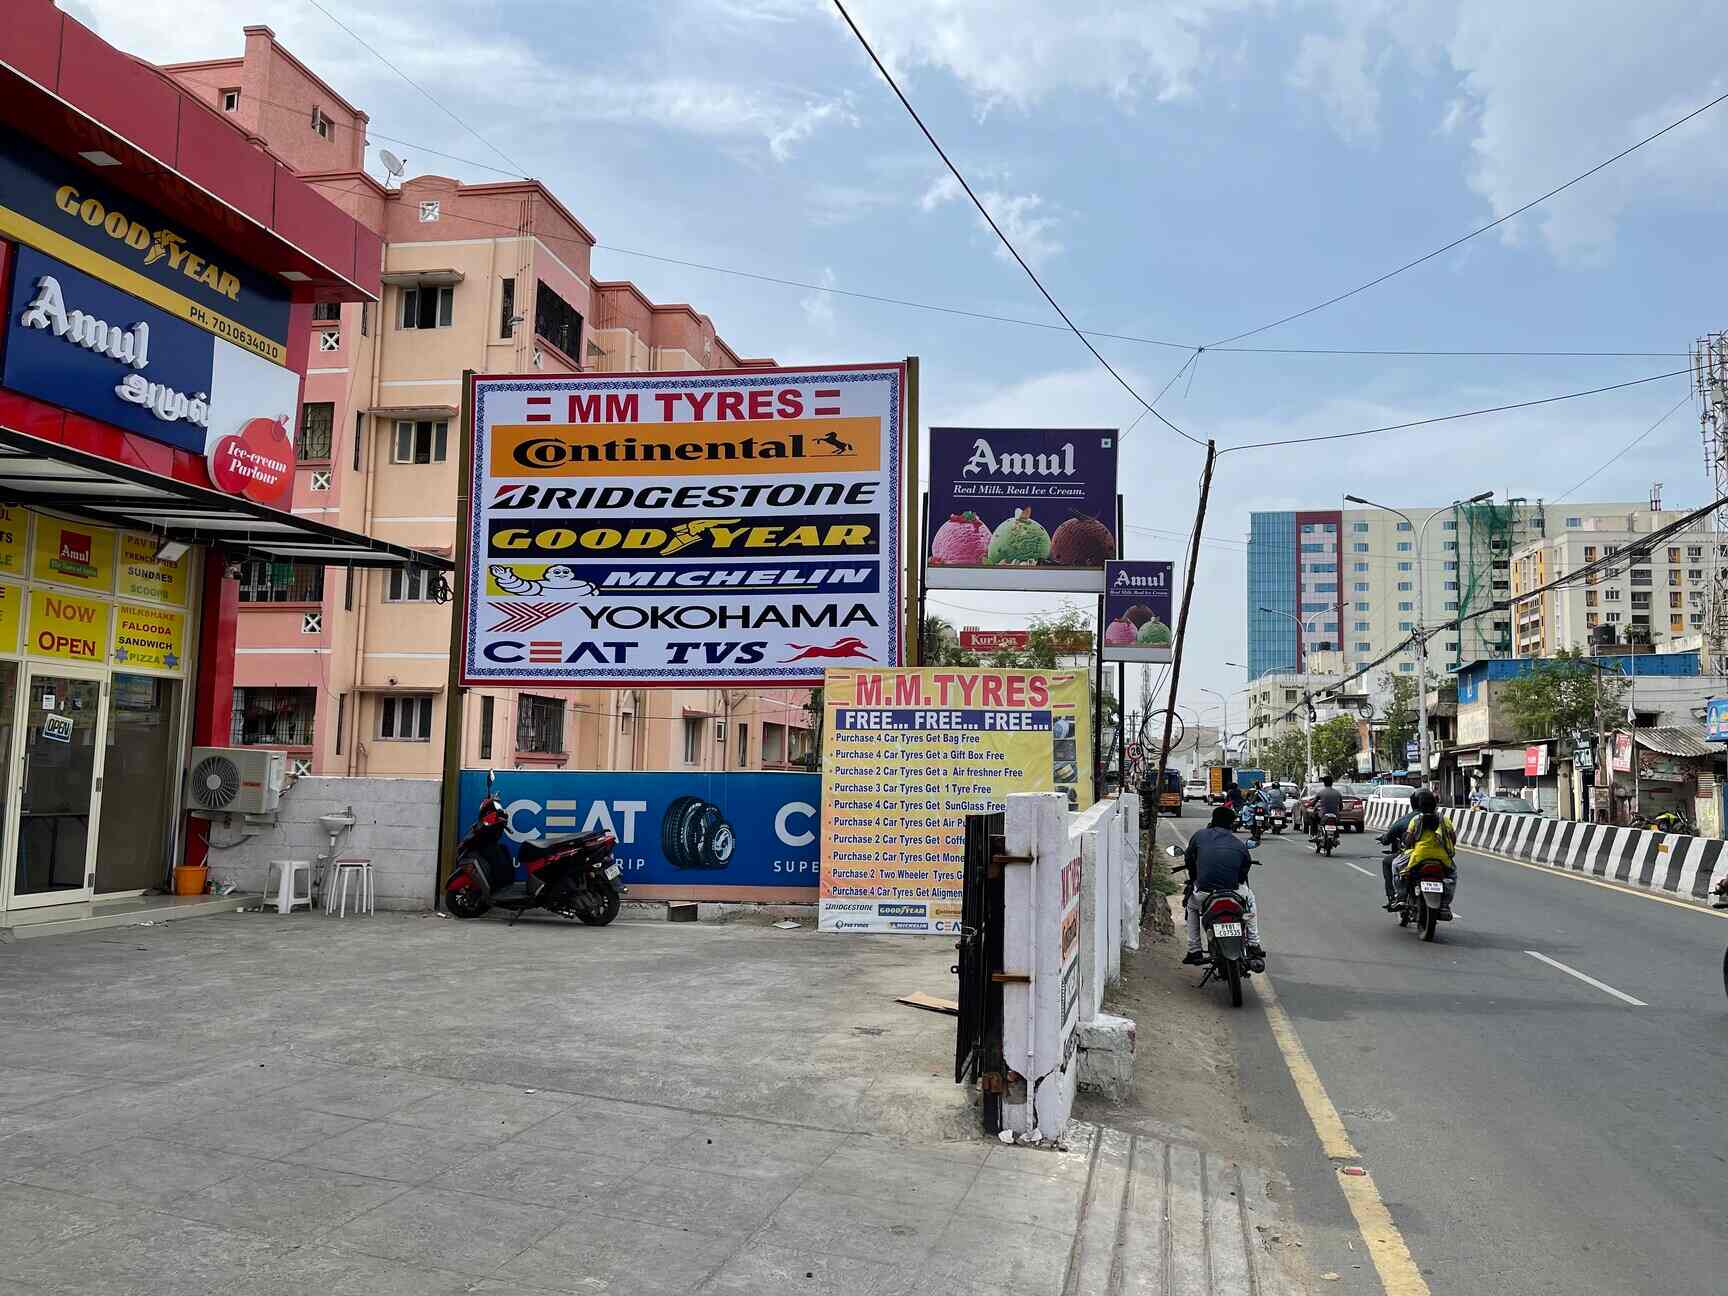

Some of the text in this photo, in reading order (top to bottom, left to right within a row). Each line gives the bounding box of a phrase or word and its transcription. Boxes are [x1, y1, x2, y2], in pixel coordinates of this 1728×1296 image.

[55, 185, 240, 301] GOODYEAR
[21, 276, 149, 369] Amul
[190, 306, 278, 359] PH. 7010634010
[568, 389, 804, 424] MM TYRES
[227, 441, 288, 473] Ice-cream
[513, 434, 806, 469] Continental
[962, 438, 1077, 479] Amul
[229, 458, 278, 485] Parlour
[488, 481, 880, 510] BRIDGESTONE
[953, 484, 1086, 496] Real Milk. Real Ice Cream.
[491, 521, 872, 555] GOODYEAR
[61, 543, 89, 562] Amul
[127, 565, 173, 584] SUNDAES
[602, 567, 873, 588] MICHELIN
[1113, 569, 1165, 588] Amul
[579, 603, 879, 630] YOKOHAMA
[122, 620, 172, 636] FALOODA
[38, 630, 96, 657] OPEN
[118, 636, 173, 650] SANDWICH
[129, 652, 161, 665] PIZZA
[483, 641, 768, 665] CEAT TVS
[47, 718, 71, 736] OPEN
[845, 711, 1049, 731] FREE... FREE... FREE...
[836, 733, 980, 744] Purchase 4 Car Tyres Get Bag Free
[835, 750, 874, 759] Purchase
[876, 750, 881, 759] 4
[884, 750, 898, 759] Car
[900, 750, 923, 761] Tyres
[926, 751, 940, 759] Get
[950, 750, 966, 759] Gift
[968, 751, 983, 759] Box
[986, 751, 1004, 759] Free
[835, 766, 873, 775] Purchase
[876, 766, 881, 775] 2
[883, 767, 898, 775] Car
[900, 767, 923, 777] Tyres
[926, 767, 940, 776] Get
[952, 767, 965, 776] Air
[967, 767, 1002, 776] freshner
[1004, 768, 1023, 776] Free
[834, 783, 873, 792] Purchase
[876, 783, 880, 792] 3
[883, 784, 897, 792] Car
[900, 784, 923, 794] Tyres
[926, 784, 940, 792] Get
[952, 784, 970, 795] Tyre
[973, 784, 991, 793] Free
[834, 800, 1006, 811] Purchase 4 Car Tyres Get SunGlass Free
[504, 799, 647, 844] CEAT
[834, 817, 872, 826] Purchase
[875, 817, 880, 826] 4
[883, 818, 897, 826] Car
[900, 818, 923, 828] Tyres
[925, 818, 940, 827] Get
[943, 818, 955, 827] Air
[833, 834, 872, 843] Purchase
[875, 834, 880, 843] 2
[882, 835, 897, 843] Car
[900, 835, 922, 846] Tyres
[925, 835, 940, 844] Get
[833, 851, 872, 860] Purchase
[875, 852, 880, 860] 2
[882, 852, 897, 861] Car
[900, 852, 922, 863] Tyres
[925, 853, 940, 861] Get
[832, 869, 868, 878] Purchase
[870, 869, 875, 878] 2
[880, 870, 895, 878] Two
[898, 870, 928, 879] Wheeler
[934, 871, 955, 881] Tyres
[832, 886, 867, 895] Purchase
[869, 887, 874, 895] 4
[877, 887, 890, 896] Car
[893, 887, 913, 898] Tyres
[916, 888, 929, 896] Get
[935, 921, 961, 931] CEA
